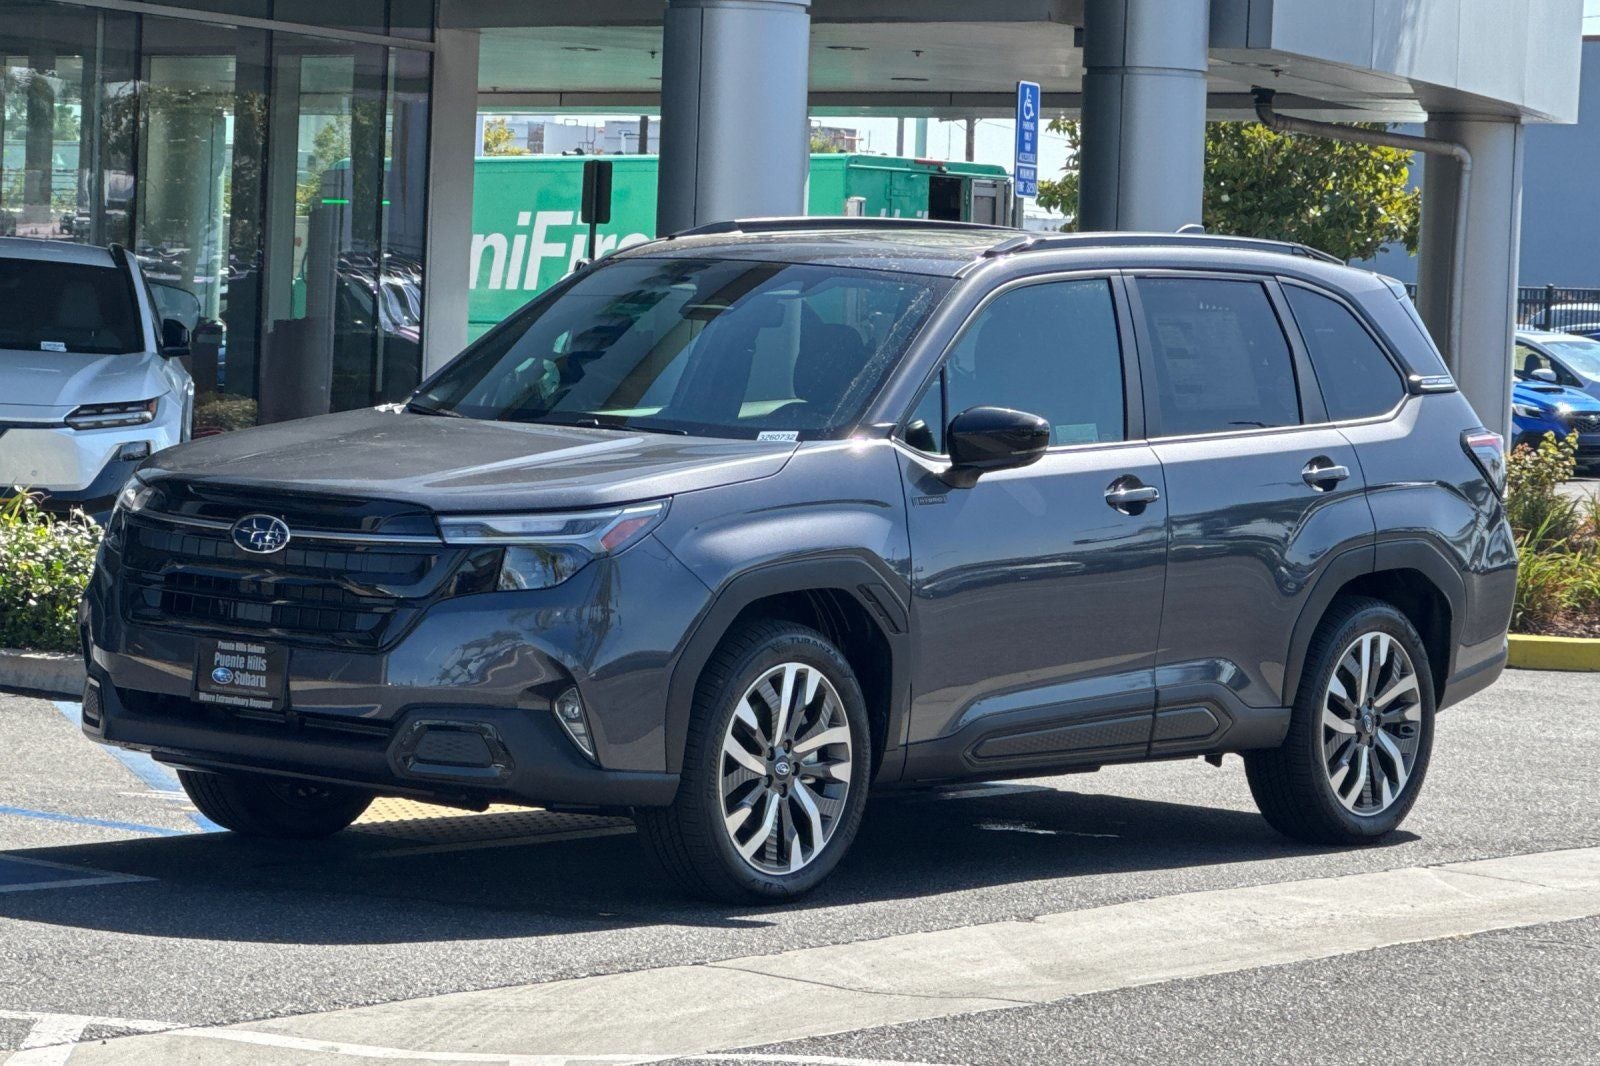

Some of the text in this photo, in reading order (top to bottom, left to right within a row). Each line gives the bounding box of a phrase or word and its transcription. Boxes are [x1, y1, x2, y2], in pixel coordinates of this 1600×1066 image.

[217, 641, 266, 654] Puente Hills Subaru
[214, 652, 267, 672] Puente Hills
[234, 671, 266, 687] Subaru
